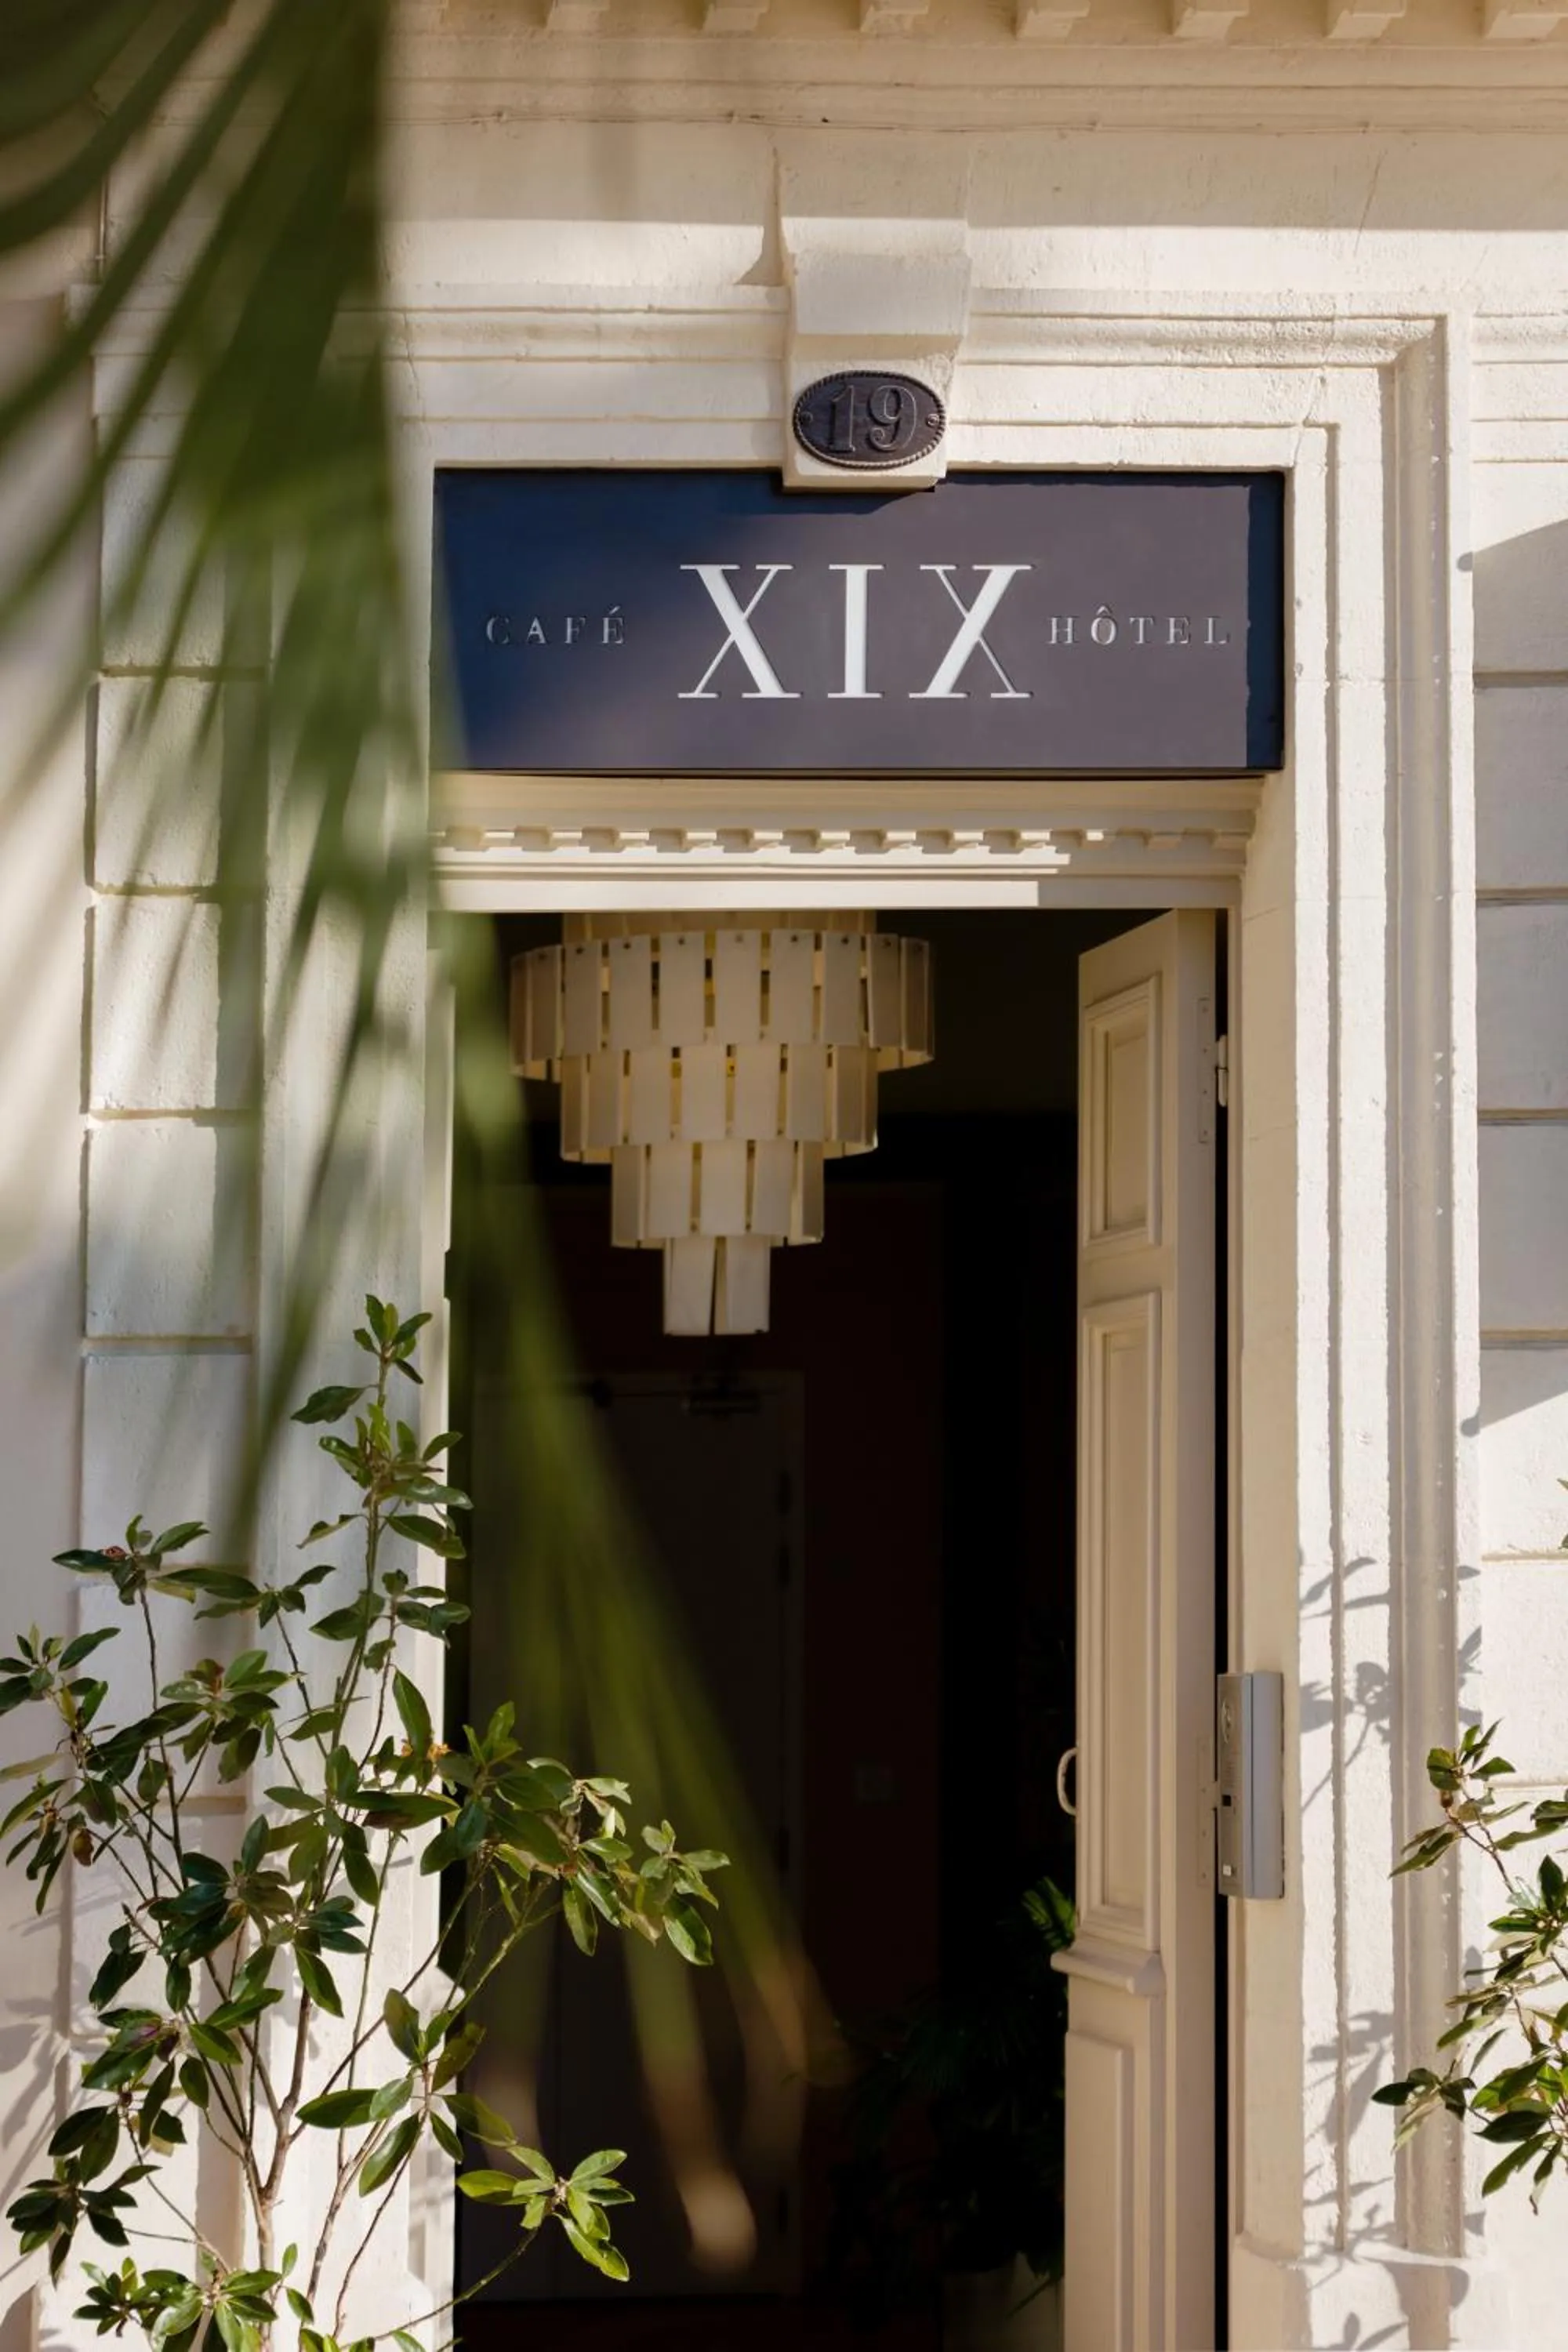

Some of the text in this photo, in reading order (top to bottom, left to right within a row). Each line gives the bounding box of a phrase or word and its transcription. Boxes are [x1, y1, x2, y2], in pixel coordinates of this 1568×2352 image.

[829, 384, 917, 452] 19
[485, 564, 1230, 699] CAFÉ XIX HÔTEL
